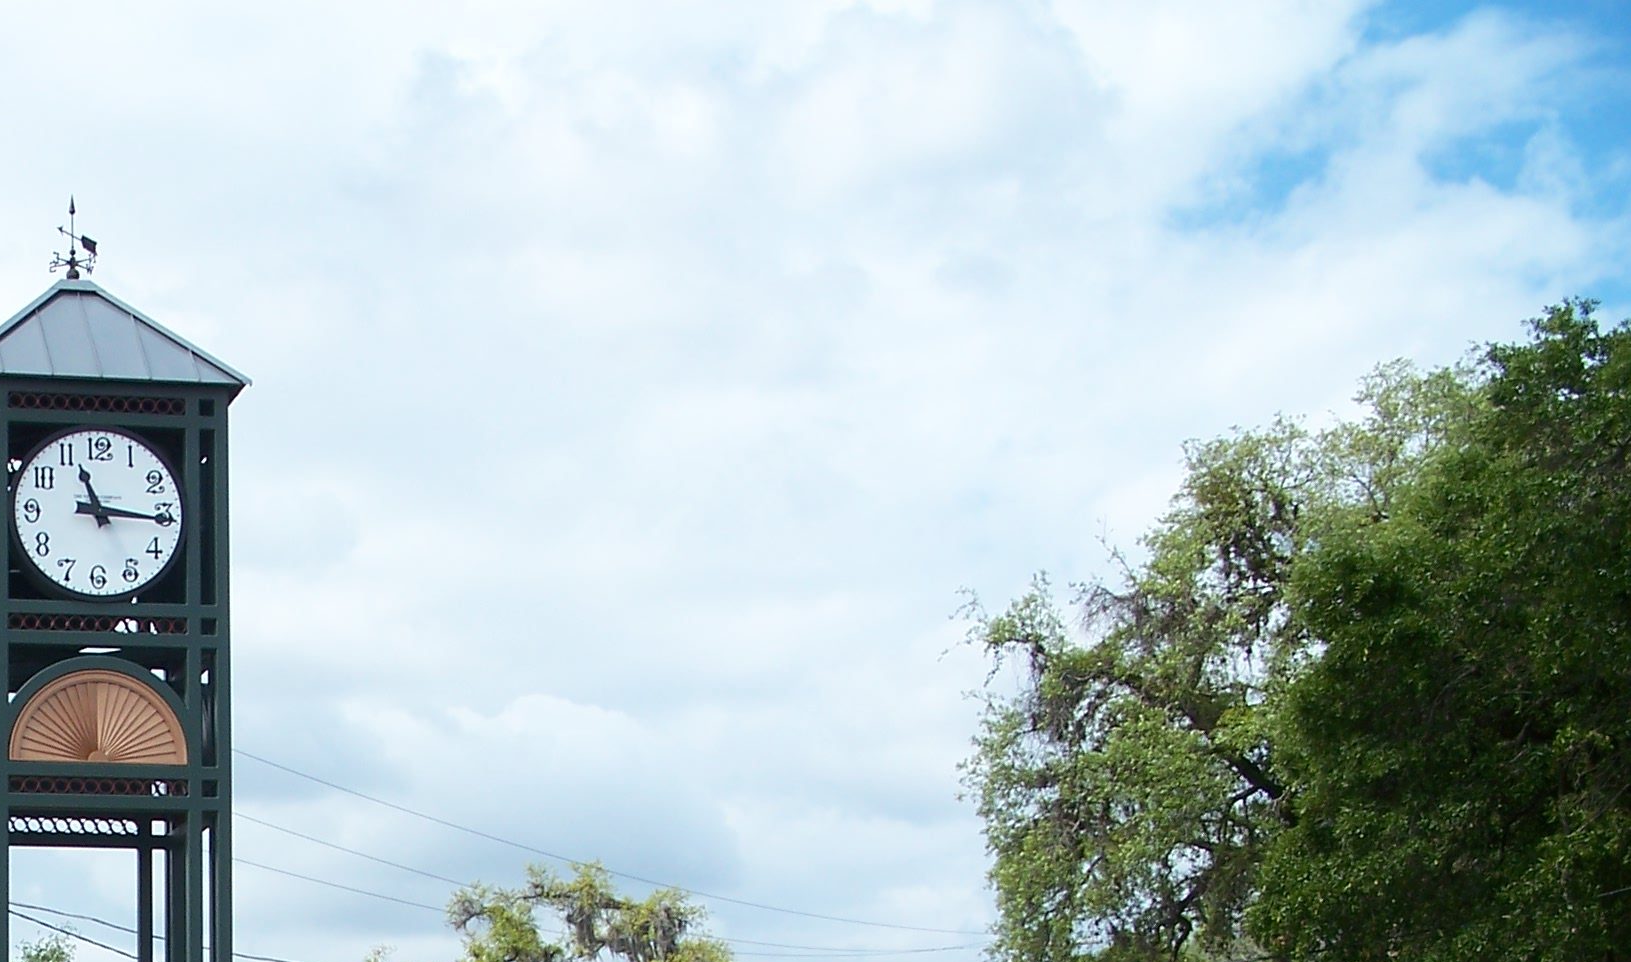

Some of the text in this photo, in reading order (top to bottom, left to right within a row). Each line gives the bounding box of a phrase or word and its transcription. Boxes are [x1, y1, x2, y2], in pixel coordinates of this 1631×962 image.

[60, 443, 73, 466] 11
[88, 437, 113, 461] 12
[127, 444, 134, 468] 1
[34, 466, 54, 490] 10
[145, 470, 165, 494] 2
[23, 498, 41, 523] 9
[154, 502, 173, 527] 3
[35, 532, 49, 557] 8
[145, 537, 163, 560] 4
[57, 558, 76, 582] 7
[89, 565, 107, 589] 6
[122, 558, 139, 582] 5
